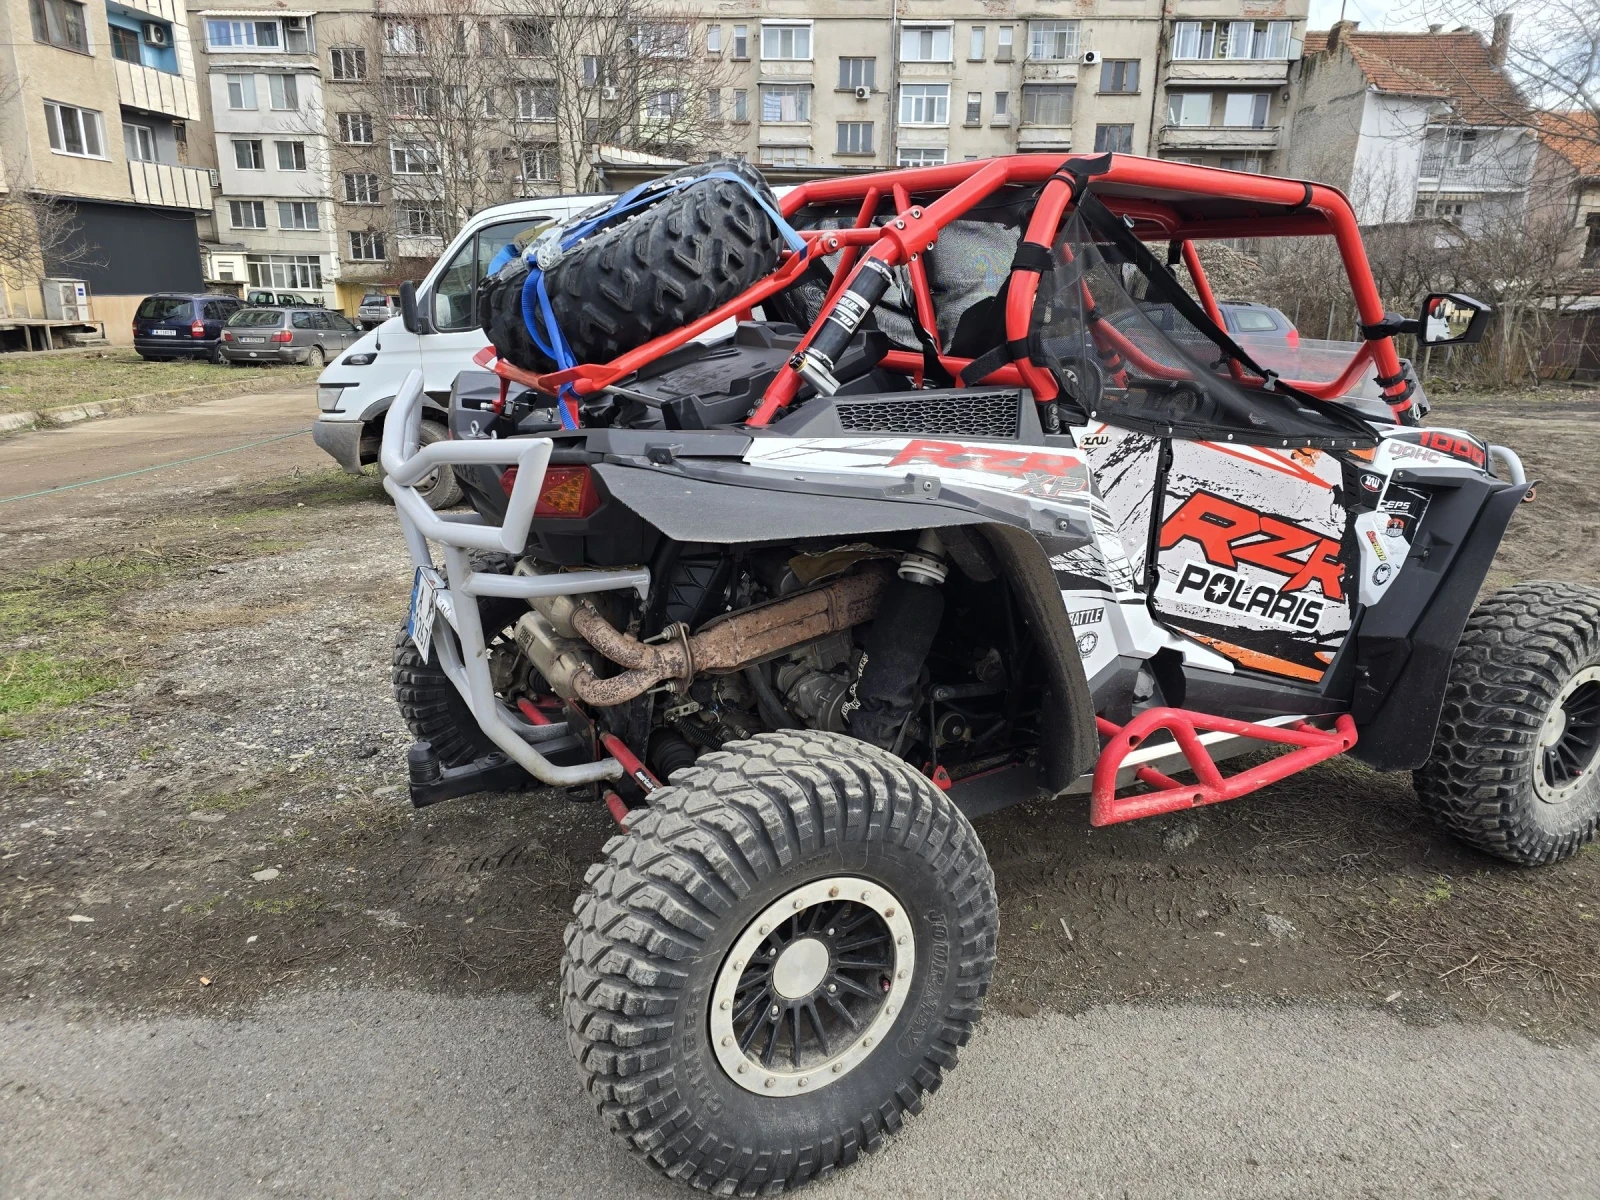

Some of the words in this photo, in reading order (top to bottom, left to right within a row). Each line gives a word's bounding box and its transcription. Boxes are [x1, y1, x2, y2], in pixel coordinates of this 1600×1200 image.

[886, 439, 1082, 477] RZR
[1388, 442, 1442, 464] DOHC
[1418, 431, 1486, 467] 1000
[1012, 473, 1088, 497] XP
[1386, 501, 1411, 510] EPS
[1158, 489, 1345, 603] RZR
[1175, 563, 1325, 629] POLARIS
